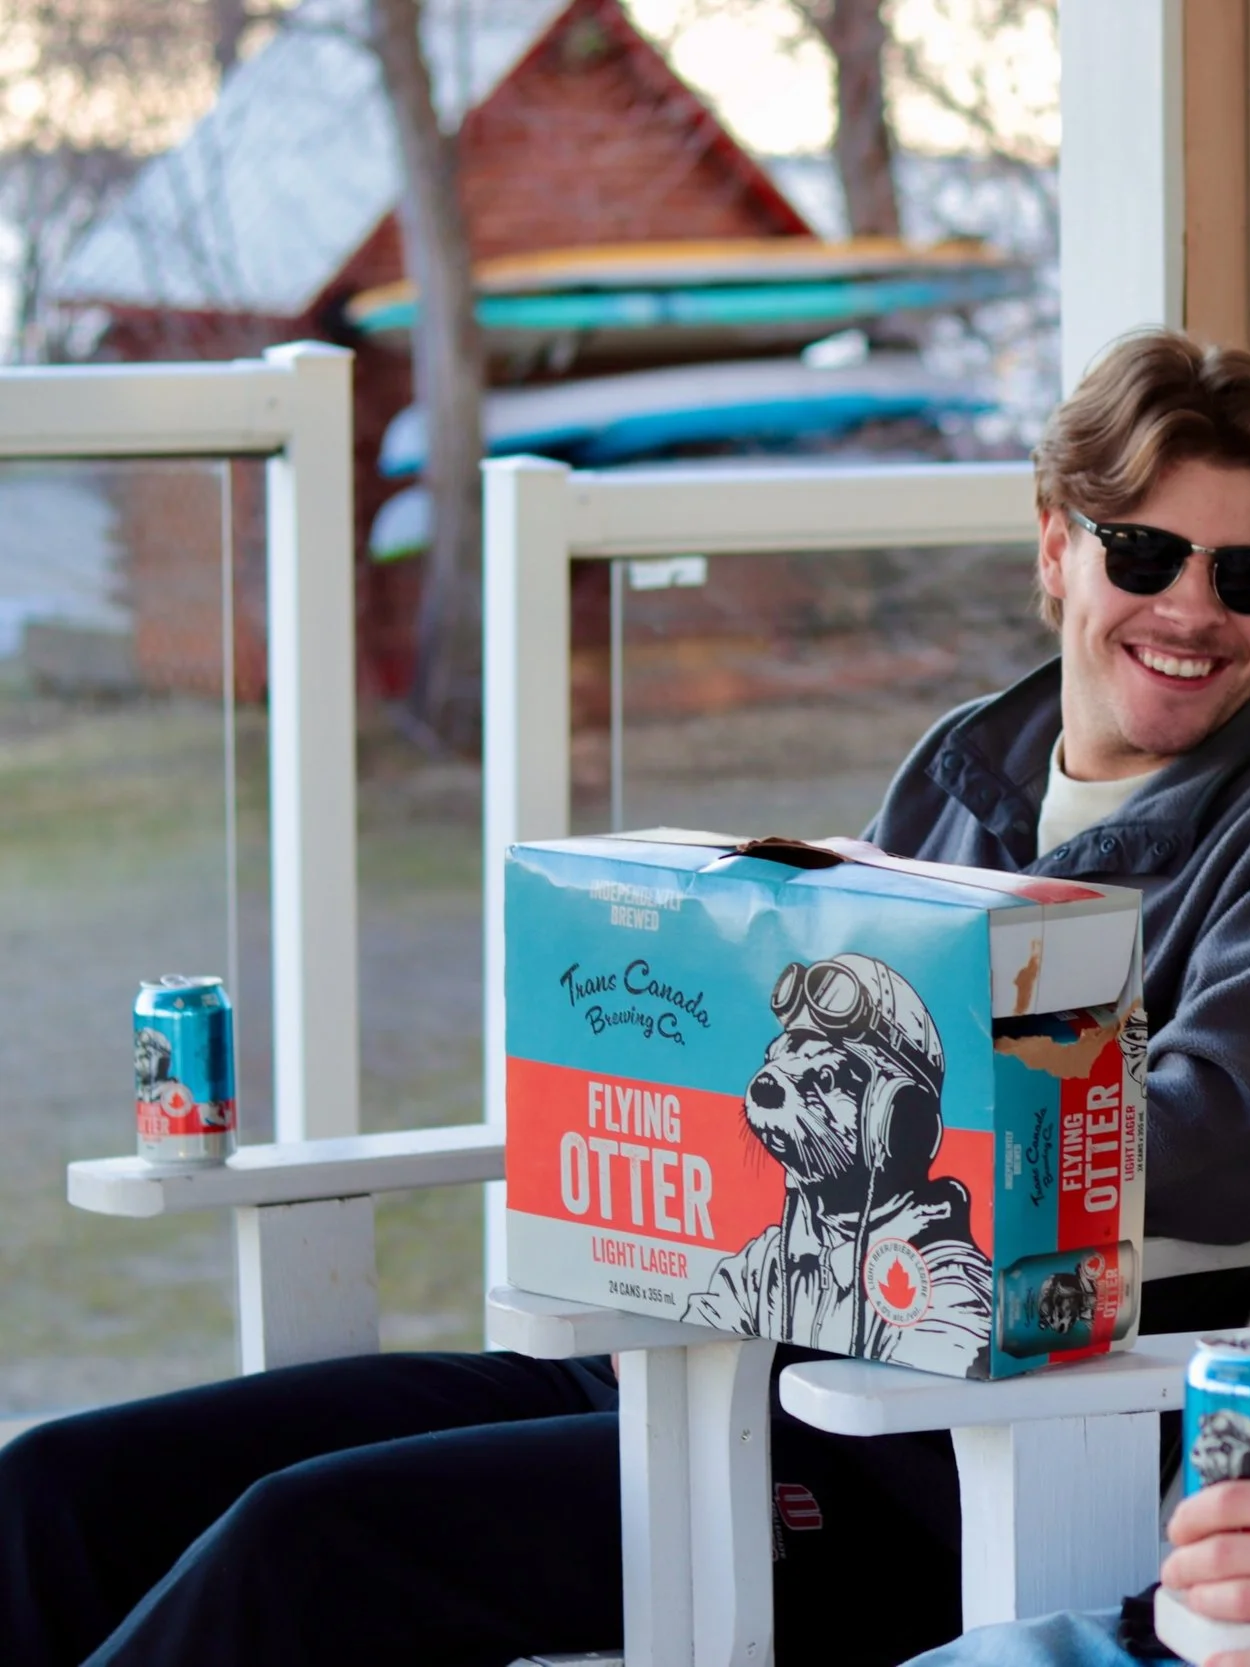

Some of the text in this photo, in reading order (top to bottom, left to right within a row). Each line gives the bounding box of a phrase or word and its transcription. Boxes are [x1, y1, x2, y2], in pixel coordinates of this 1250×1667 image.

[610, 905, 660, 932] BREWED
[560, 959, 712, 1028] Trans Canada
[585, 1005, 686, 1046] Brewing Co.
[588, 1081, 681, 1144] FLYING
[1025, 1107, 1047, 1164] Canada
[1062, 1112, 1084, 1192] FLYING
[1084, 1083, 1120, 1213] OTTER
[1125, 1105, 1135, 1181] LIGHT LAGER
[559, 1131, 715, 1240] OTTER
[592, 1236, 688, 1279] LIGHT LAGER
[609, 1280, 618, 1294] 24
[619, 1282, 641, 1299] CANS
[648, 1287, 663, 1304] 355
[663, 1291, 676, 1305] mL
[1103, 1268, 1118, 1318] OTTER
